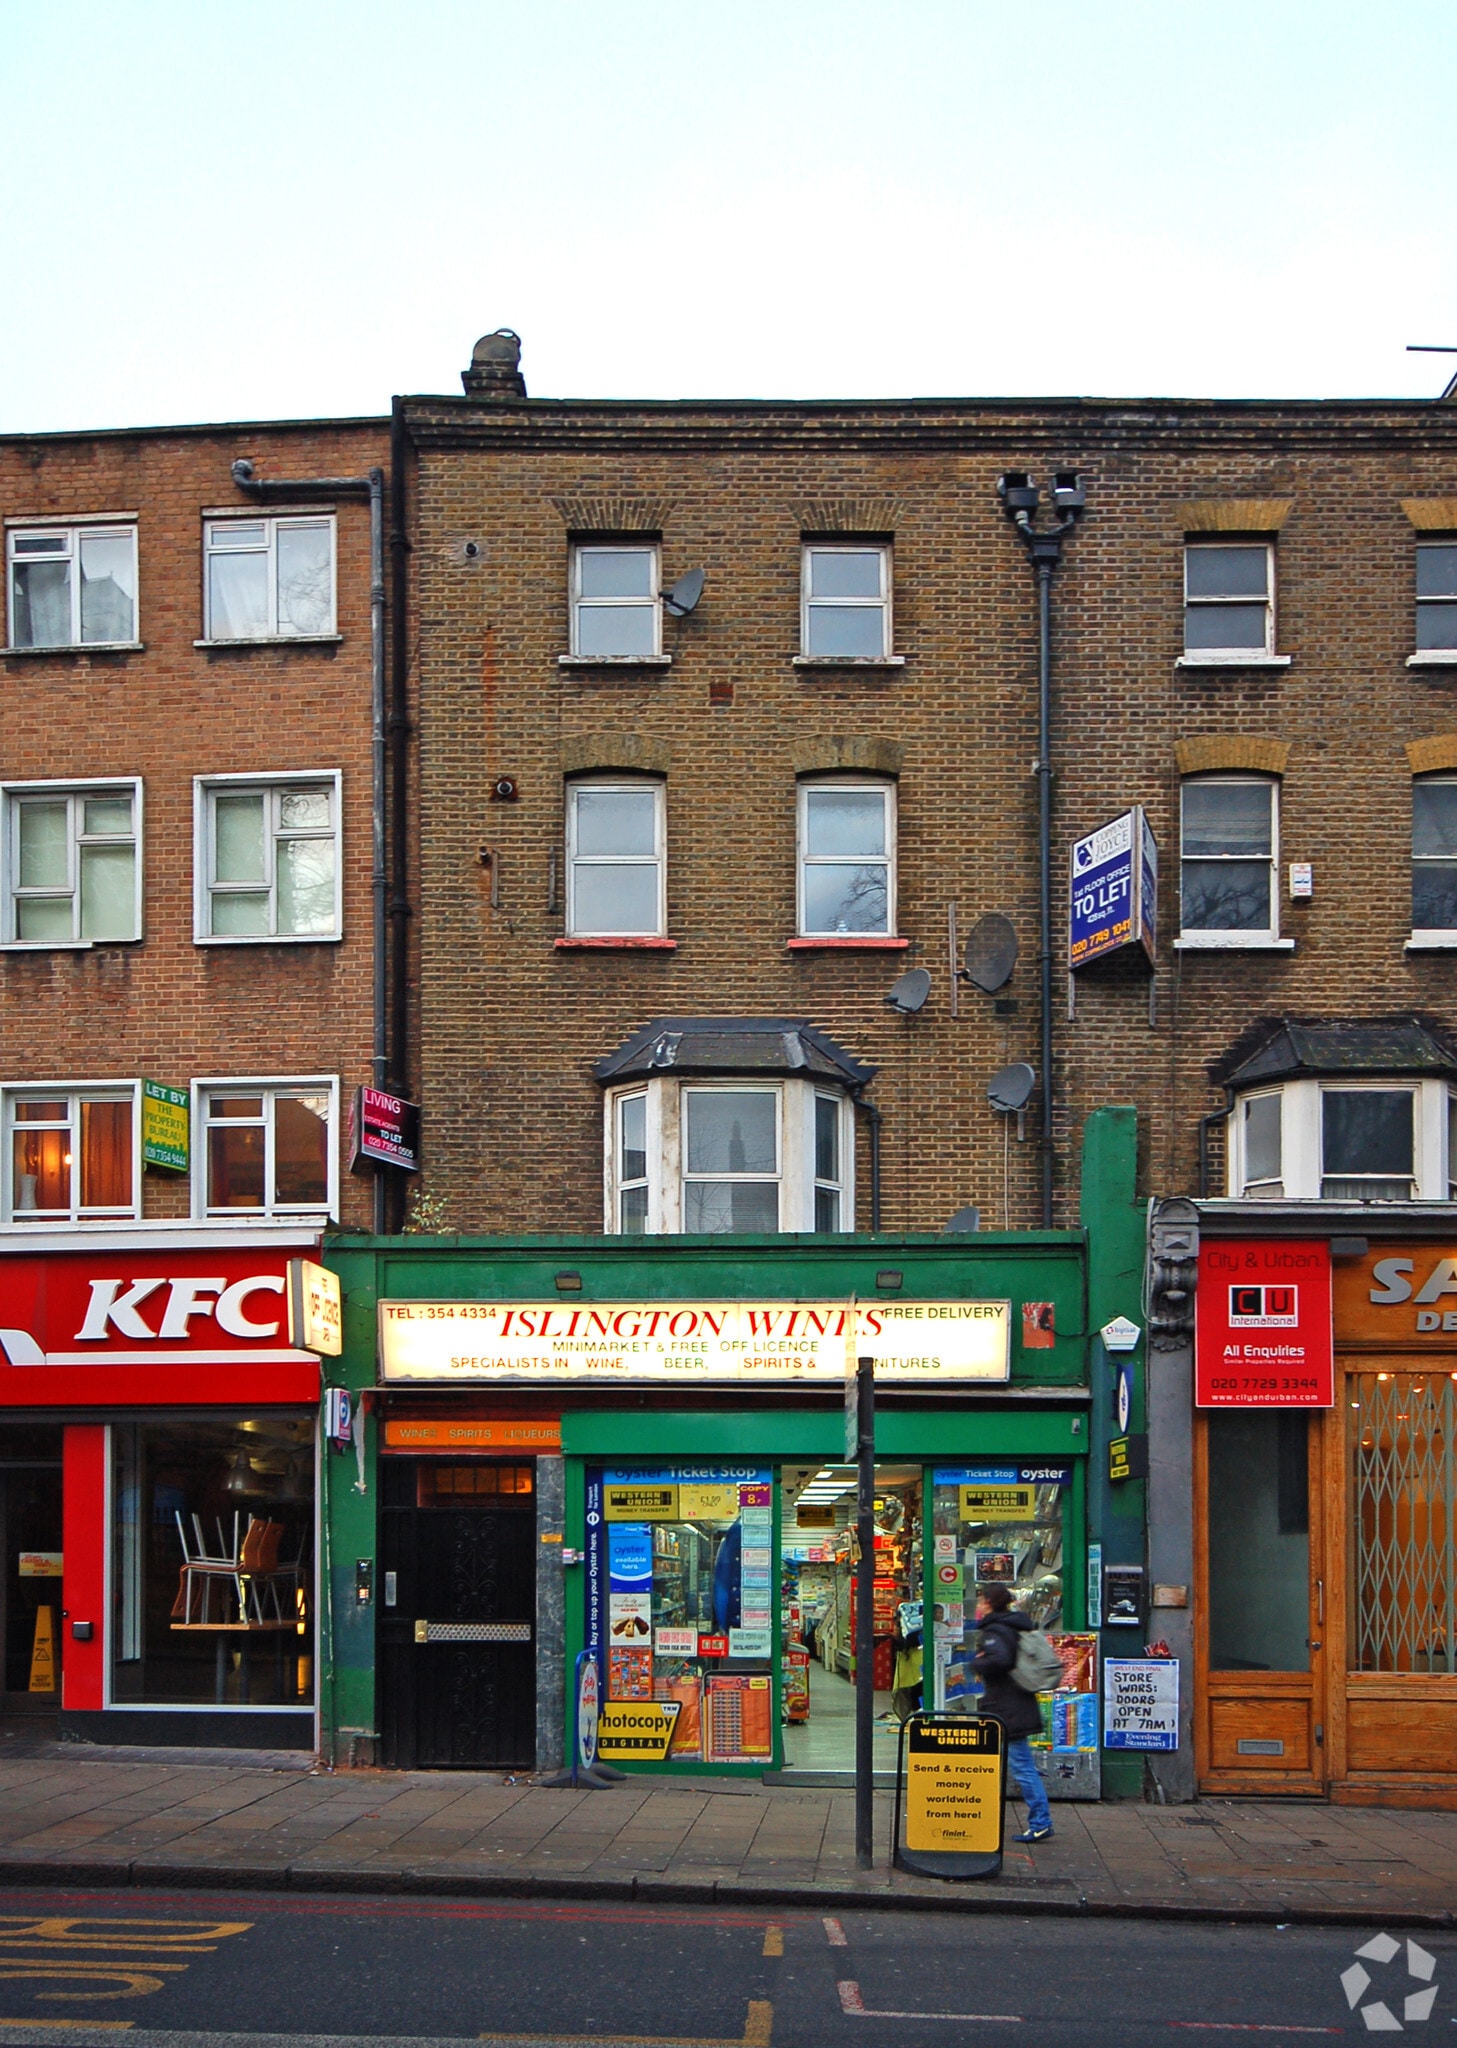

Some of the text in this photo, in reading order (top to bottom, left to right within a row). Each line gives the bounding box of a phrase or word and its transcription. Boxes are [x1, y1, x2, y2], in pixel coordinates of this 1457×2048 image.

[1096, 829, 1128, 858] JOYCE
[1084, 876, 1106, 893] FLOOR
[1107, 863, 1130, 881] OFFICE
[1074, 876, 1130, 919] TO LET
[1072, 938, 1087, 956] 020
[146, 1083, 187, 1105] LET BY
[364, 1089, 401, 1114] LIVING
[157, 1103, 173, 1116] THE
[146, 1111, 186, 1130] PROPERTY
[368, 1136, 381, 1147] 020
[380, 1129, 402, 1143] TO LET
[1207, 1251, 1239, 1272] City
[1244, 1251, 1257, 1268] &
[73, 1275, 286, 1341] KFC
[427, 1307, 455, 1319] 354
[460, 1307, 497, 1319] 4334
[884, 1306, 1004, 1319] FREE DELIVERY
[498, 1310, 728, 1337] ISLINGTON
[1230, 1316, 1296, 1326] International
[553, 1341, 819, 1353] MINIMARKET & FREE OFF LICENCE
[1223, 1345, 1305, 1358] All Enquiries
[450, 1357, 551, 1369] SPECIALISTS
[554, 1357, 569, 1369] IN
[585, 1357, 629, 1371] WINE,
[664, 1357, 709, 1370] BEER,
[743, 1357, 805, 1369] SPIRITS
[808, 1358, 817, 1369] &
[1211, 1378, 1318, 1389] 020 7729 3344
[1211, 1394, 1318, 1402] www.cityandurban.com
[449, 1428, 492, 1439] SPIRITS
[615, 1465, 757, 1482] oyster Ticket Stop
[965, 1470, 992, 1478] Ticket
[994, 1470, 1014, 1479] Stop
[1021, 1468, 1064, 1481] oyster
[611, 1491, 661, 1499] WESTERN
[967, 1491, 1018, 1499] WESTERN
[614, 1546, 645, 1556] oyster
[589, 1552, 599, 1577] Oyster
[591, 1579, 599, 1595] your
[591, 1596, 599, 1606] up
[591, 1607, 599, 1621] top
[591, 1622, 597, 1630] or
[590, 1632, 599, 1646] Buy
[1114, 1671, 1153, 1683] STORE
[1118, 1683, 1158, 1694] WARS:
[1116, 1694, 1156, 1705] DOORS
[1118, 1706, 1152, 1717] OPEN
[599, 1710, 673, 1732] hotocopy
[1113, 1718, 1166, 1730] AT 7AM
[920, 1728, 977, 1737] WESTERN
[1125, 1733, 1162, 1741] Evening
[602, 1739, 663, 1748] DIGITAL
[937, 1737, 977, 1745] UNION
[1124, 1739, 1166, 1747] Standard
[913, 1764, 995, 1774] Send & receive
[935, 1781, 972, 1790] money
[926, 1795, 982, 1804] worldwide
[926, 1810, 982, 1819] from here!
